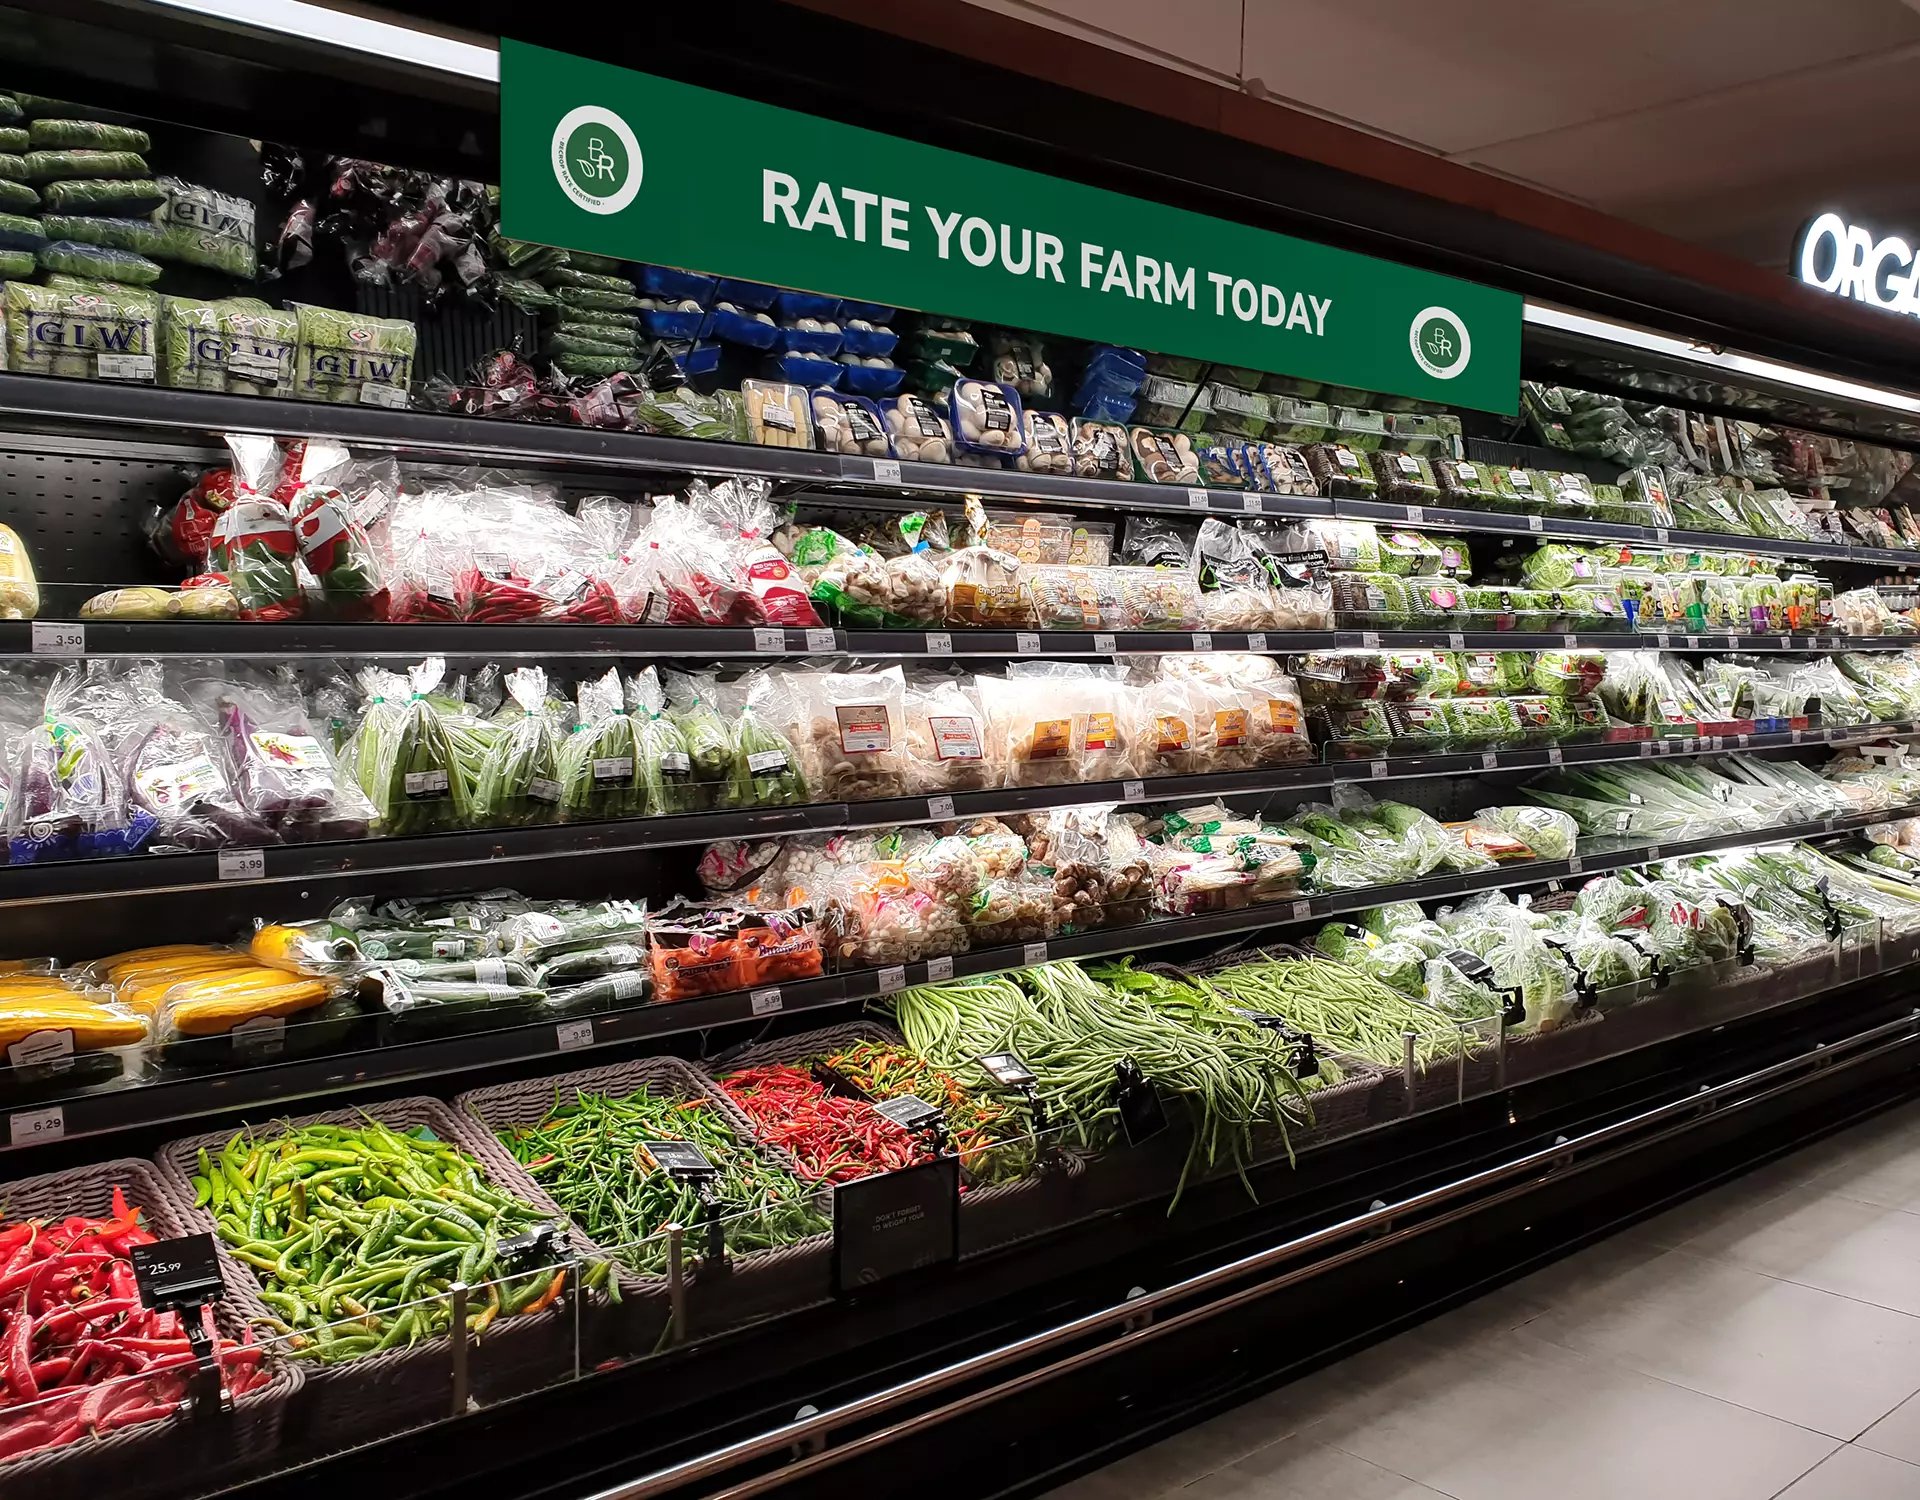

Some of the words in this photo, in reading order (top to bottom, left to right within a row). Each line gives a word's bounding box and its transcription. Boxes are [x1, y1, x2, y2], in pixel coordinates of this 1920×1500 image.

[557, 140, 566, 170] BECROP
[562, 170, 574, 188] RATE
[572, 187, 602, 207] CERTIFIED
[762, 169, 910, 252] RATE
[924, 206, 1066, 284] YOUR
[1080, 242, 1196, 311] FARM
[1208, 271, 1332, 337] TODAY
[56, 635, 83, 646] 3.50
[239, 859, 263, 870] 3.99
[764, 995, 780, 1006] 5.99
[34, 1117, 61, 1132] 6.29
[149, 1262, 182, 1276] 25.99
